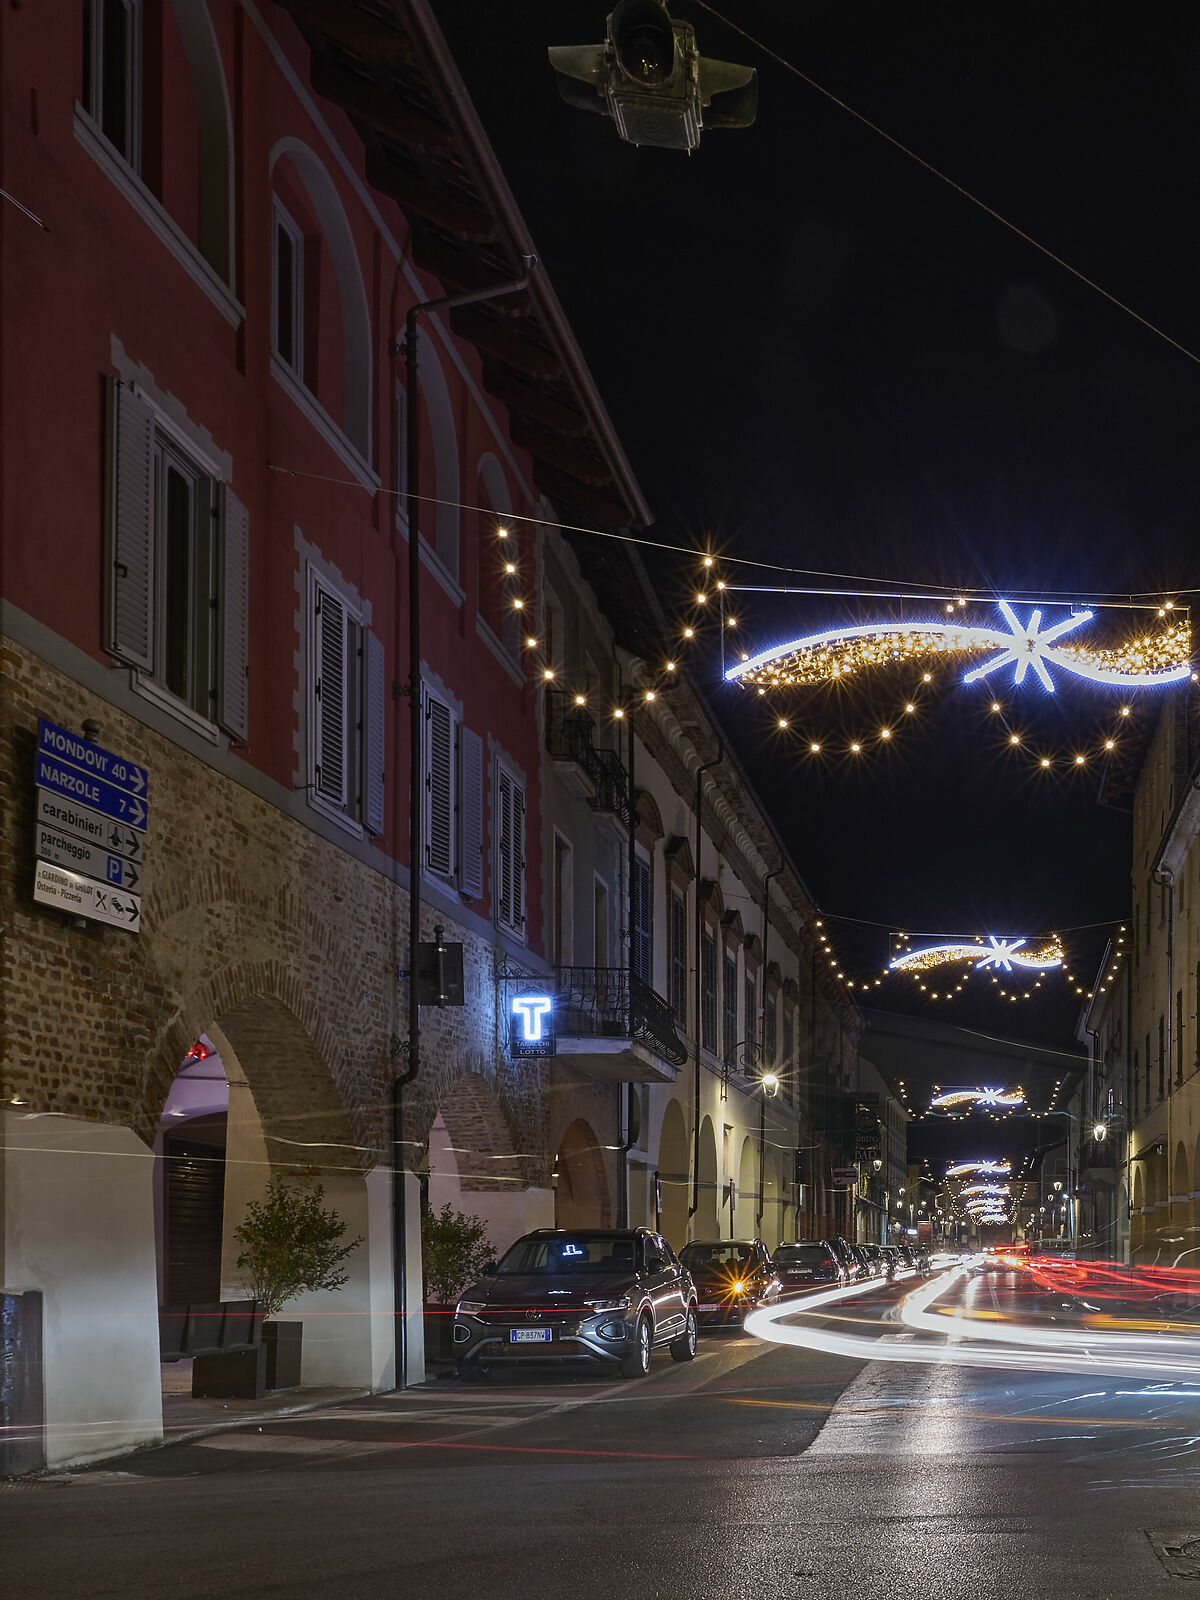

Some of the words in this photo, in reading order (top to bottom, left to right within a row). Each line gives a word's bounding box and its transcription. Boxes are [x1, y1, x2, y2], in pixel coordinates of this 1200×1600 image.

[111, 763, 127, 781] 40
[41, 763, 100, 802] NARZOLE
[119, 799, 127, 813] 7
[43, 803, 103, 837] carabinieri
[41, 832, 90, 860] parcheggio
[42, 870, 69, 887] GIARDINO
[110, 859, 119, 879] P
[37, 881, 57, 895] Osteria
[60, 888, 82, 903] Pizzeria
[512, 997, 551, 1040] T
